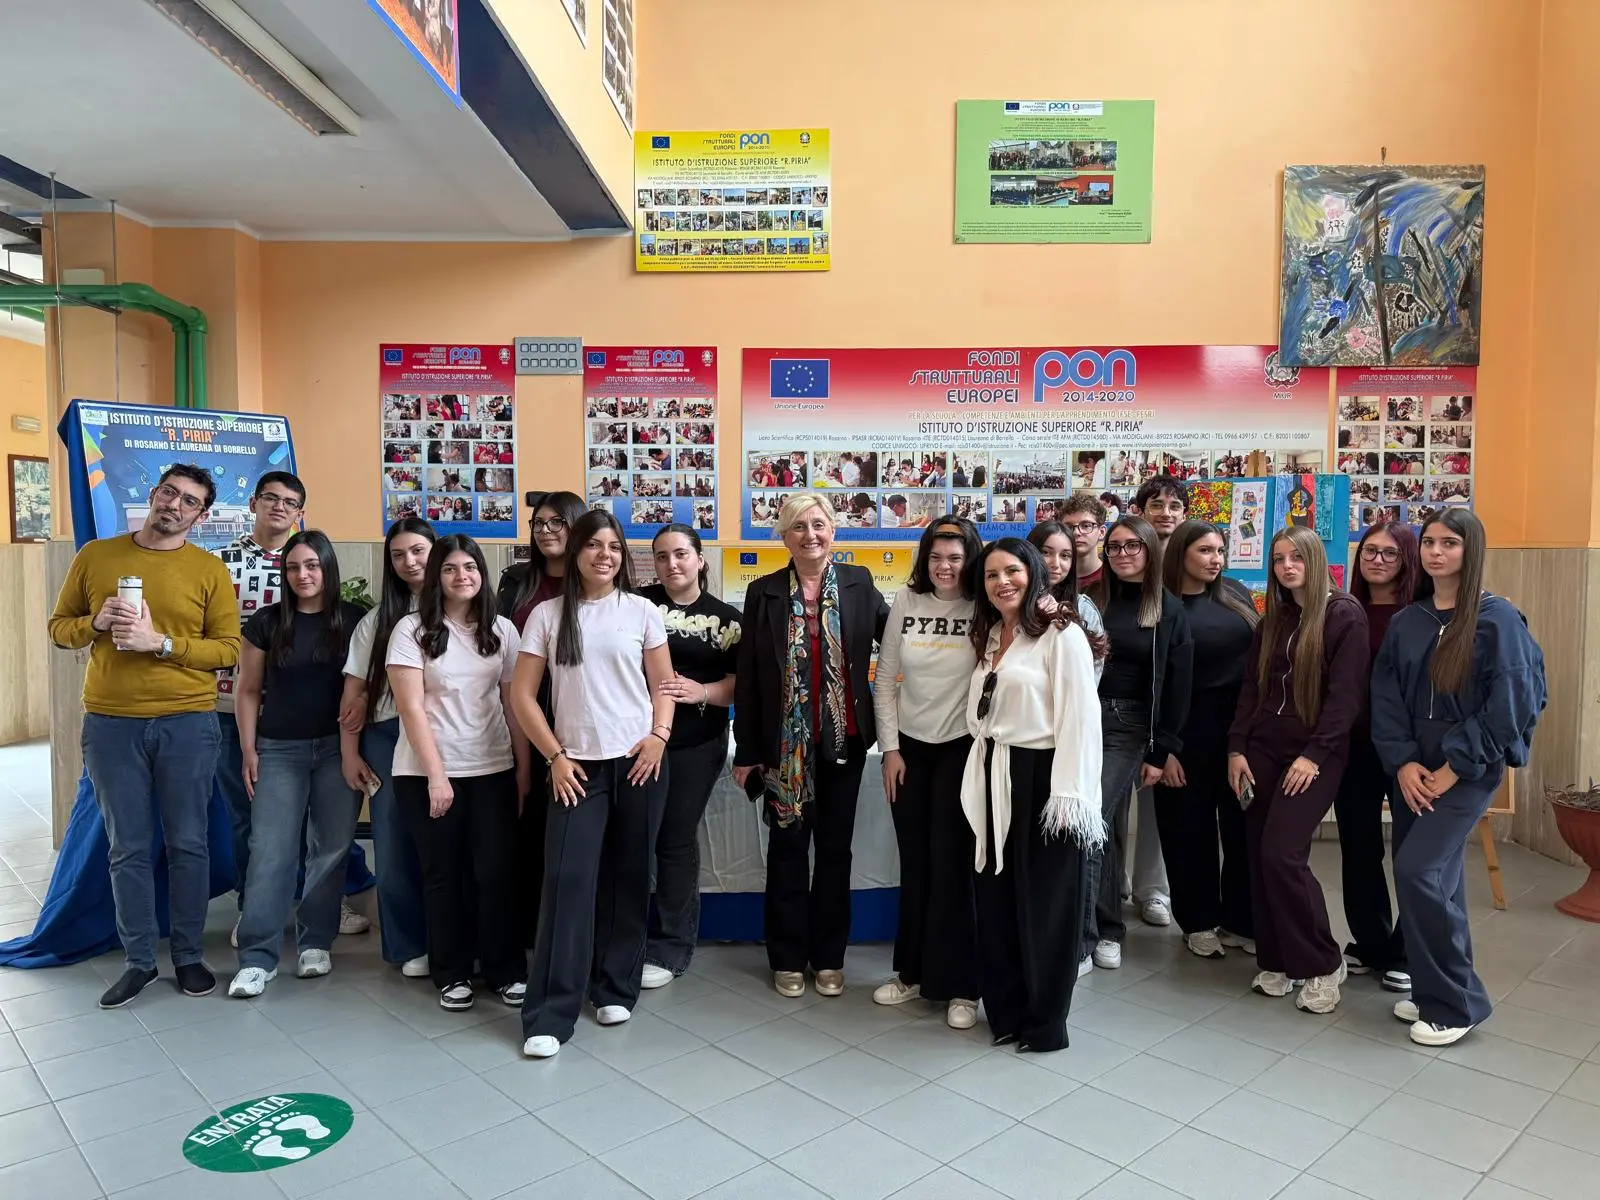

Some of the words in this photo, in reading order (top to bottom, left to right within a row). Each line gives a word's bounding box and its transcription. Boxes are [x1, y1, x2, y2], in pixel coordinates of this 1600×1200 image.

[739, 132, 770, 150] pon
[652, 158, 685, 167] ISTITUTO
[687, 158, 738, 166] D'ISTRUZIONE
[740, 157, 778, 166] SUPERIORE
[449, 346, 481, 364] pon
[652, 349, 685, 367] pon
[967, 350, 1020, 366] FONDI
[908, 369, 1020, 385] STRUTTURALI
[1032, 348, 1137, 403] pon
[946, 388, 1019, 404] EUROPEI
[1062, 390, 1136, 403] 2014-2020
[798, 403, 825, 411] Europea
[962, 411, 1003, 419] COMPETENZE
[109, 412, 151, 426] ISTITUTO
[153, 415, 214, 431] D'ISTRUZIONE
[216, 419, 263, 434] SUPERIORE
[918, 422, 963, 433] ISTITUTO
[966, 421, 1038, 433] D'ISTRUZIONE
[1041, 421, 1097, 432] SUPERIORE
[124, 439, 133, 448] DI
[134, 439, 169, 450] ROSARNO
[170, 442, 175, 450] E
[176, 442, 213, 453] LAUREANA
[214, 444, 222, 453] DI
[223, 445, 257, 455] BORRELLO
[901, 616, 975, 636] PYRE
[188, 1095, 295, 1146] ENTRATA
